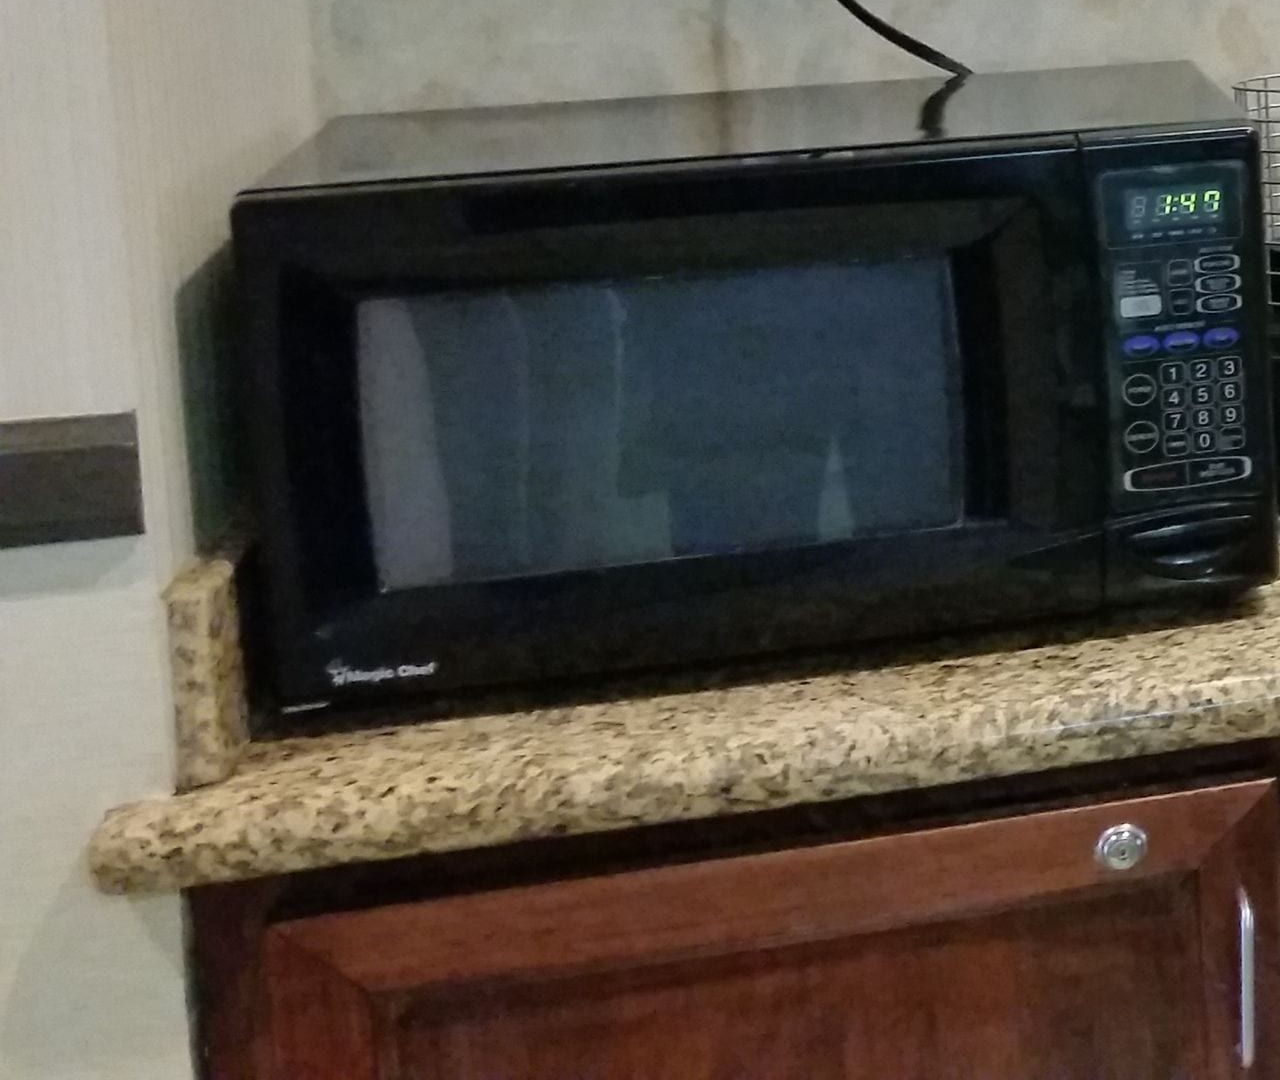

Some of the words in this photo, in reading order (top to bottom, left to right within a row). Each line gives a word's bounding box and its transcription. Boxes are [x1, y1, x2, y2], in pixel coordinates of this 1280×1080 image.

[1165, 190, 1220, 215] 1:47
[1169, 367, 1177, 380] 1
[1196, 364, 1207, 377] 2
[1224, 360, 1235, 375] 3
[1168, 391, 1179, 404] 4
[1197, 387, 1208, 402] 5
[1224, 384, 1236, 398] 6
[1169, 414, 1180, 428] 7
[1198, 410, 1209, 424] 8
[1225, 407, 1237, 422] 9
[1199, 433, 1210, 447] 0
